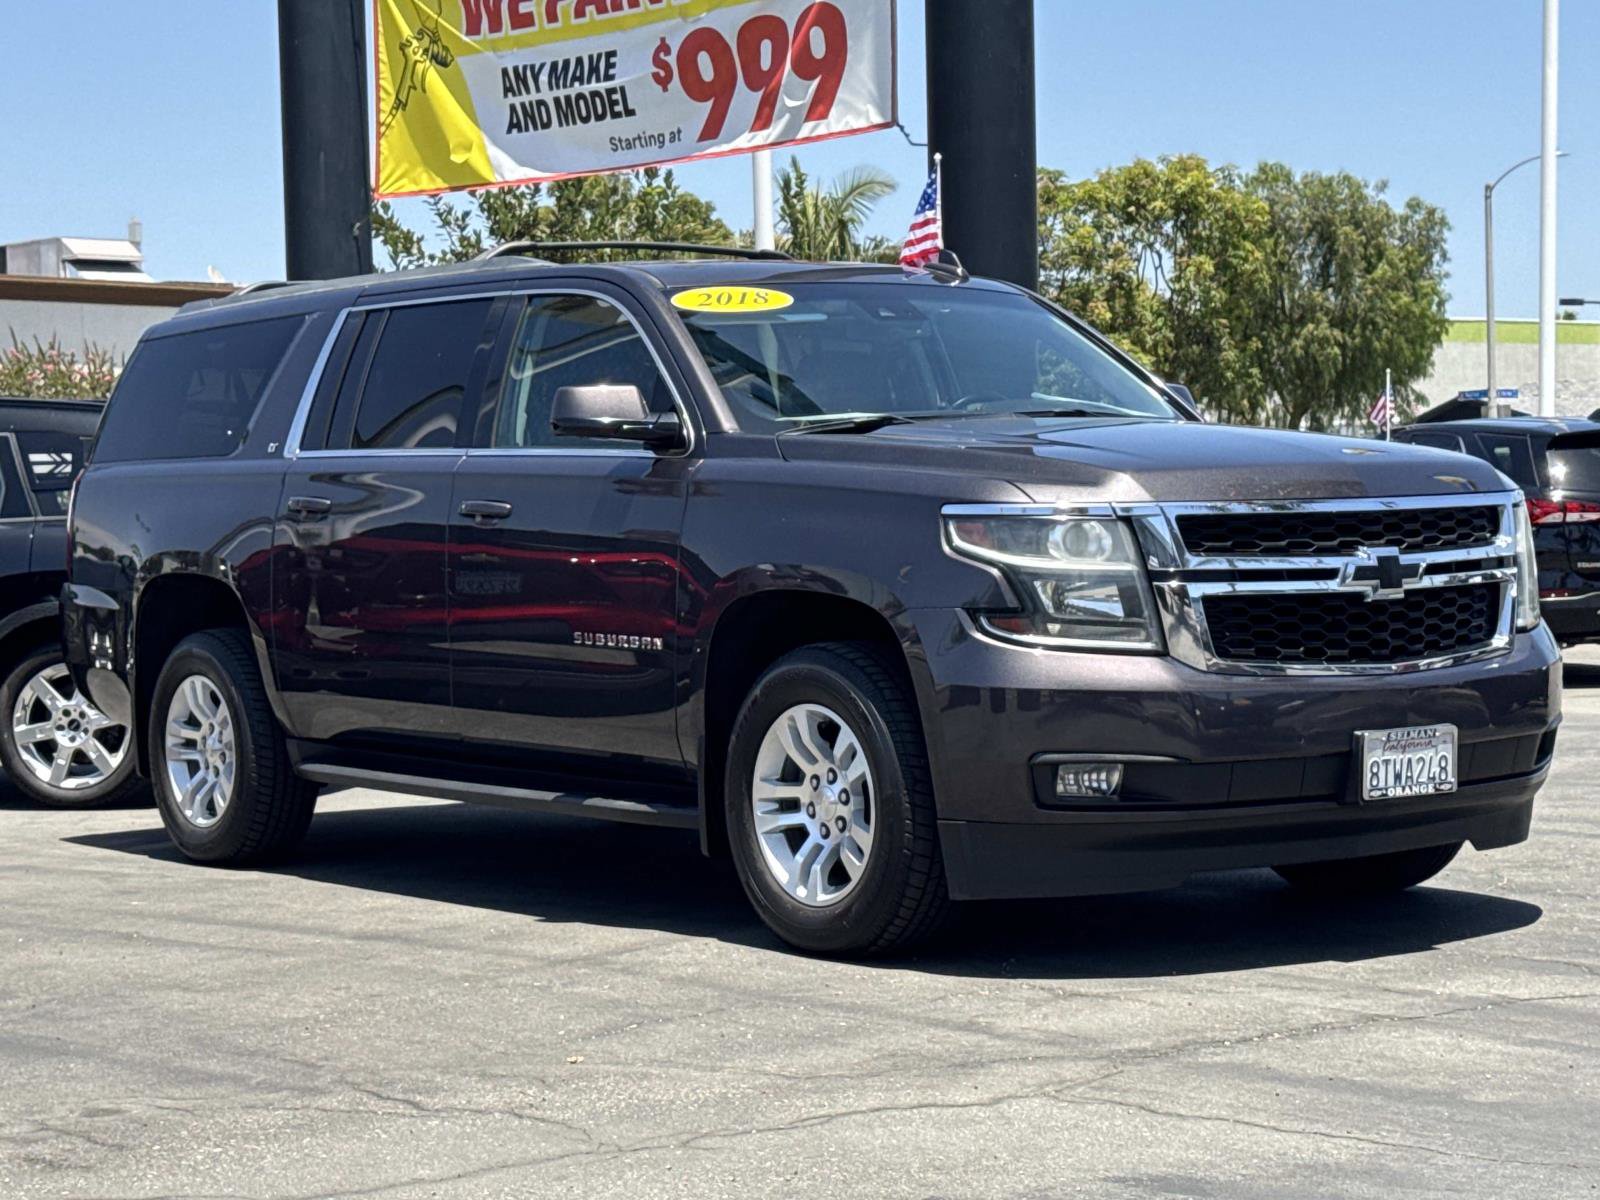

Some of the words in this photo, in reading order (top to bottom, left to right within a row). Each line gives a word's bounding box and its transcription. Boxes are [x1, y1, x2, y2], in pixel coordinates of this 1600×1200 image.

[501, 62, 547, 99] ANY
[548, 49, 618, 91] MAKE
[651, 1, 848, 143] $999
[506, 99, 554, 135] AND
[553, 85, 636, 128] MODEL
[609, 130, 665, 152] Starting
[669, 127, 682, 144] at
[697, 291, 769, 307] 2018
[573, 631, 663, 650] SUBURBAN
[1383, 739, 1437, 754] California
[1369, 755, 1449, 788] 8TWA248
[1387, 783, 1436, 797] ORANGE
